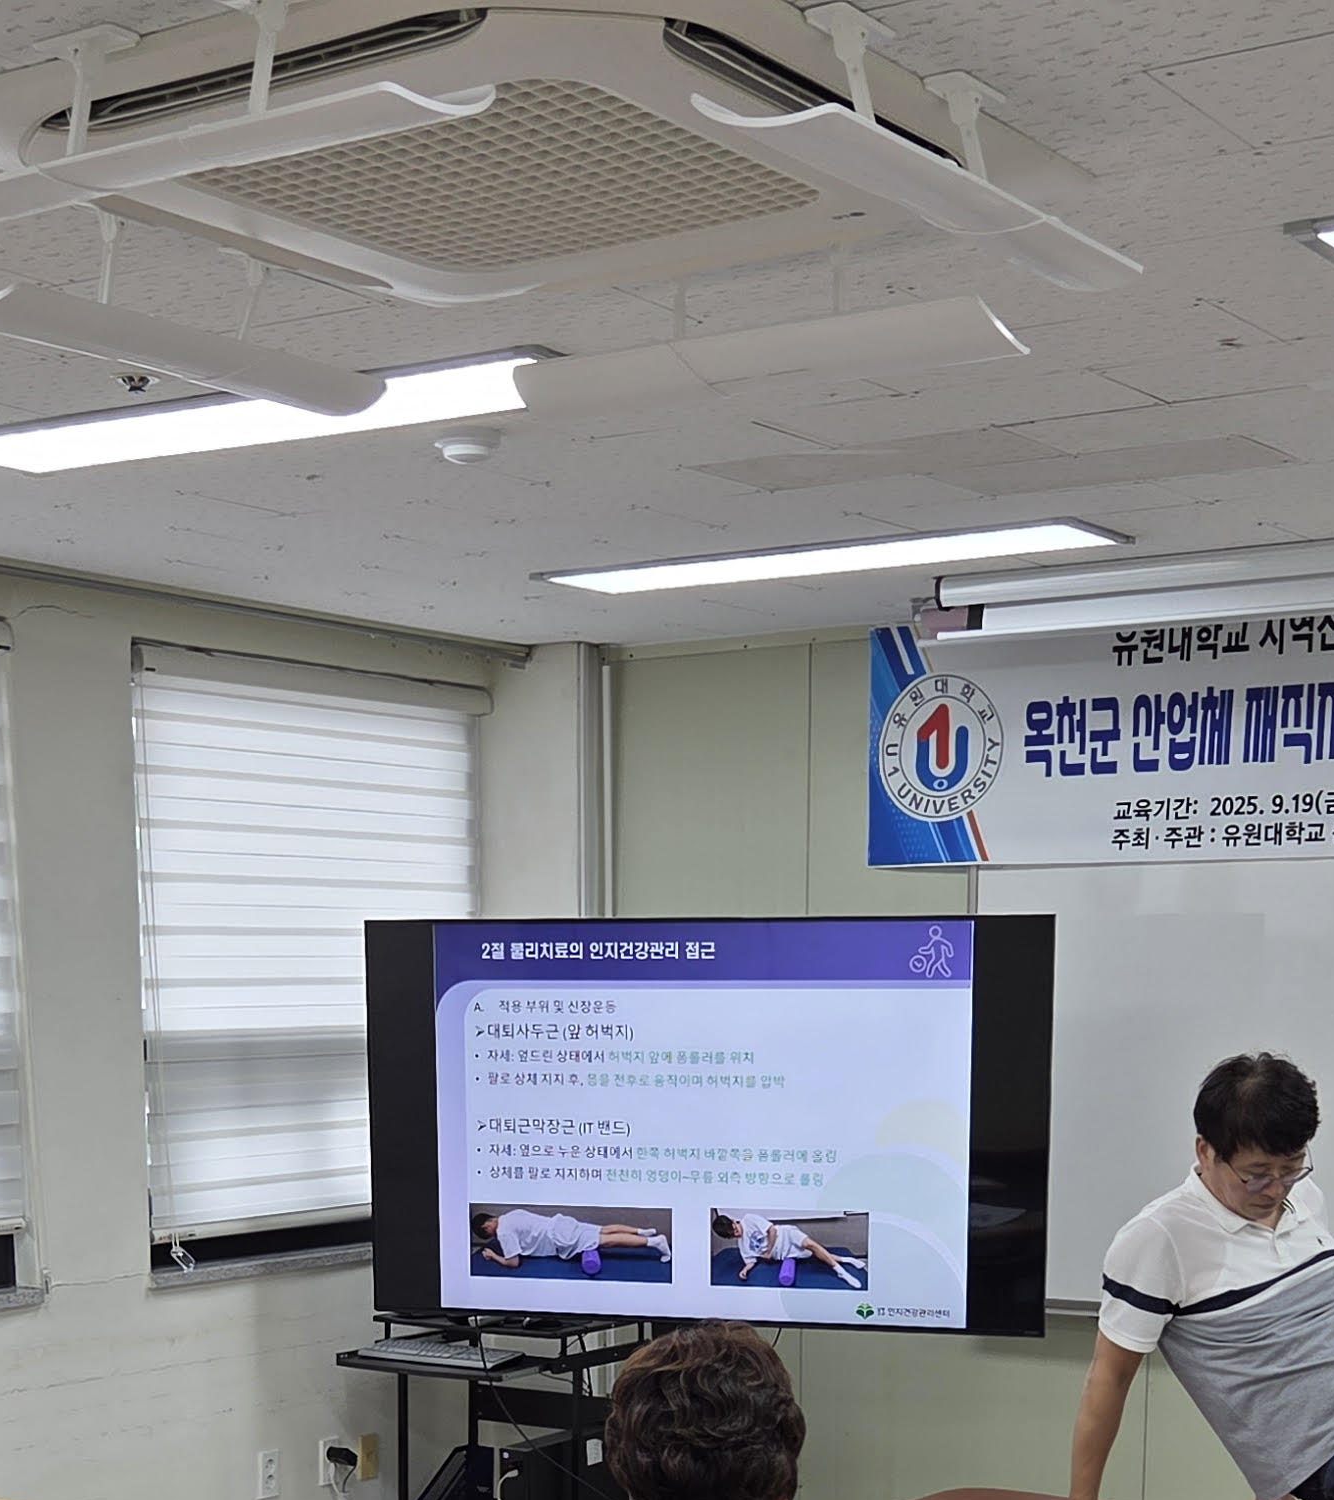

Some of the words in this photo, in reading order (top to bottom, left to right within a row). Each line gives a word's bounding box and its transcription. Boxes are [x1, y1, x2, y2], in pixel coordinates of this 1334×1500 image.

[1024, 696, 1121, 777] 옥천군
[1132, 687, 1234, 772] 산업체
[897, 738, 1001, 814] UNIVERSITY
[1113, 797, 1198, 821] 교육기간:
[1209, 796, 1264, 817] 2025.
[1222, 821, 1325, 847] 유원대학교
[481, 942, 505, 960] 2절
[510, 942, 584, 960] 물리치료의
[589, 941, 679, 959] 인지건강관리
[685, 941, 716, 959] 접근
[498, 1000, 522, 1013] 적용
[526, 1000, 549, 1013] 부위
[568, 1000, 616, 1014] 신장운동
[487, 1023, 559, 1040] 대퇴사두근
[562, 1024, 581, 1041] (앞
[585, 1024, 634, 1041] 허벅지)
[487, 1050, 514, 1063] 자세:
[556, 1050, 605, 1063] 상태에서
[608, 1051, 645, 1063] 허벅지
[730, 1052, 754, 1064] 위치
[487, 1073, 514, 1085] 팔로
[515, 1073, 538, 1086] 상체
[541, 1074, 564, 1086] 지지
[568, 1074, 584, 1086] 후,
[707, 1075, 757, 1088] 허벅지를
[489, 1118, 575, 1135] 대퇴근막장근
[578, 1122, 594, 1136] (IT
[597, 1120, 631, 1137] 밴드)
[489, 1144, 516, 1156] 자세:
[520, 1144, 554, 1158] 옆으로
[559, 1145, 581, 1159] 누운
[585, 1146, 633, 1159] 상태에서
[664, 1148, 700, 1160] 허벅지
[489, 1166, 524, 1179] 상체를
[528, 1167, 551, 1179] 팔로
[555, 1168, 602, 1181] 지지하며
